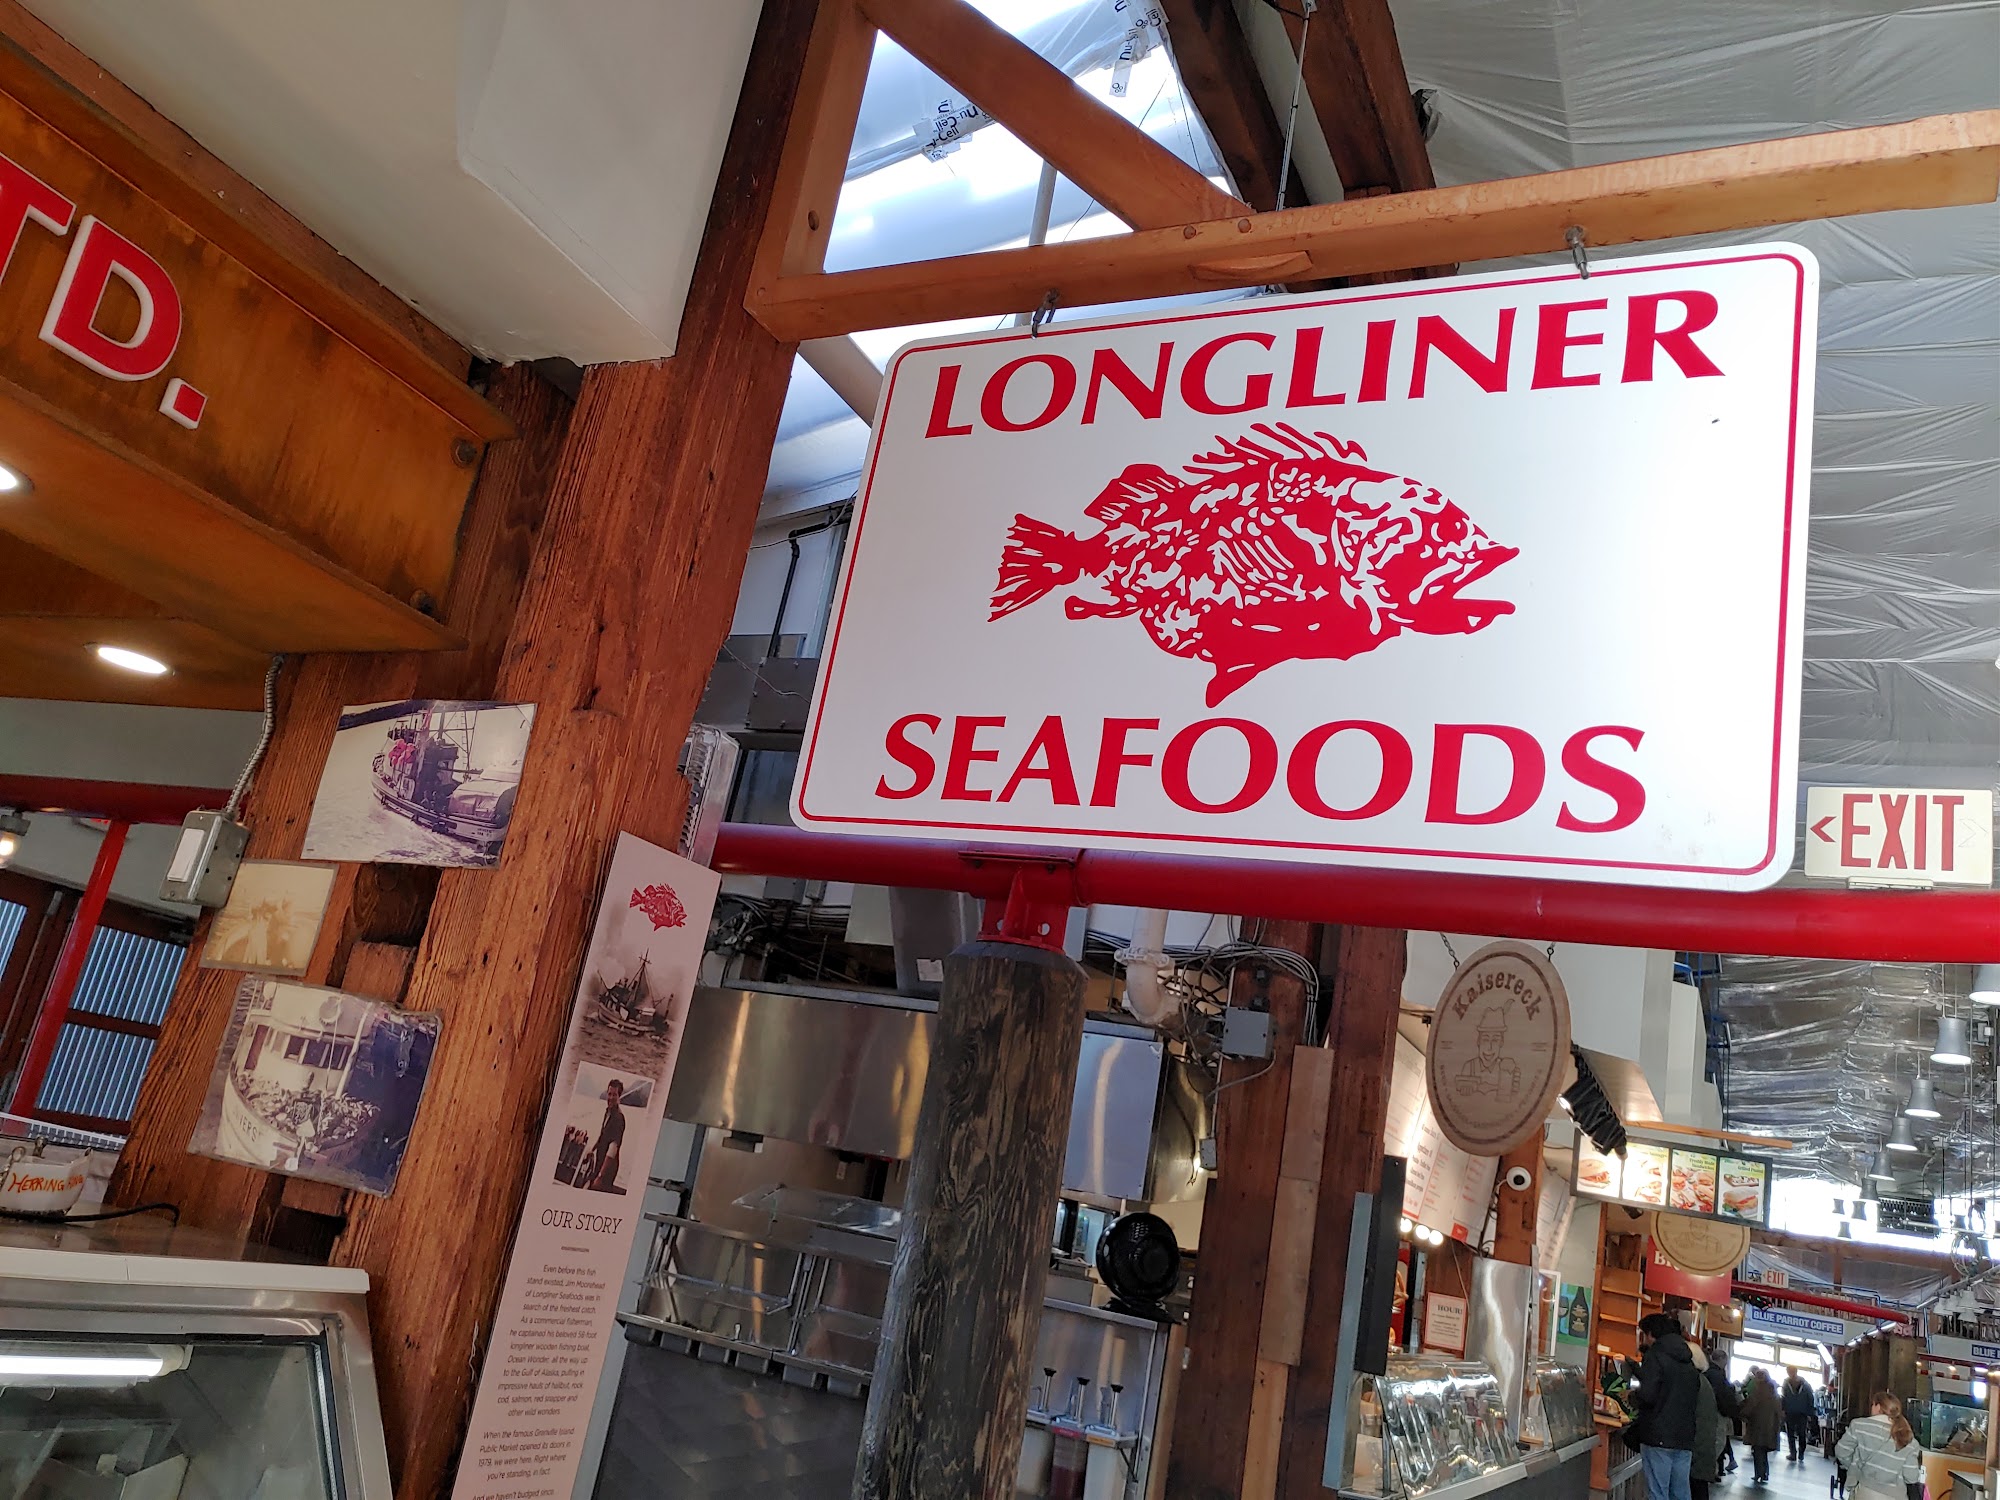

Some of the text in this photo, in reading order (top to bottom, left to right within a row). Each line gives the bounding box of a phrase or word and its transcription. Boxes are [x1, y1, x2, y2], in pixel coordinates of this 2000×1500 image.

[925, 290, 1725, 440] LONGLINER
[875, 713, 1646, 833] SEAFOODS
[1841, 793, 1965, 872] EXIT
[1452, 971, 1542, 1021] Kaisereck
[8, 1172, 65, 1193] HERRING
[541, 1208, 623, 1235] OUR STORY
[544, 1265, 557, 1273] Even
[558, 1266, 575, 1274] before
[1766, 1270, 1786, 1286] EXIT
[533, 1291, 558, 1299] Longliner
[560, 1292, 583, 1300] Seafoods
[1753, 1310, 1775, 1322] BLUE
[1776, 1314, 1809, 1328] PARROT
[1810, 1321, 1843, 1334] COFFEE
[1972, 1346, 1996, 1358] BLUE
[513, 1429, 533, 1437] famous
